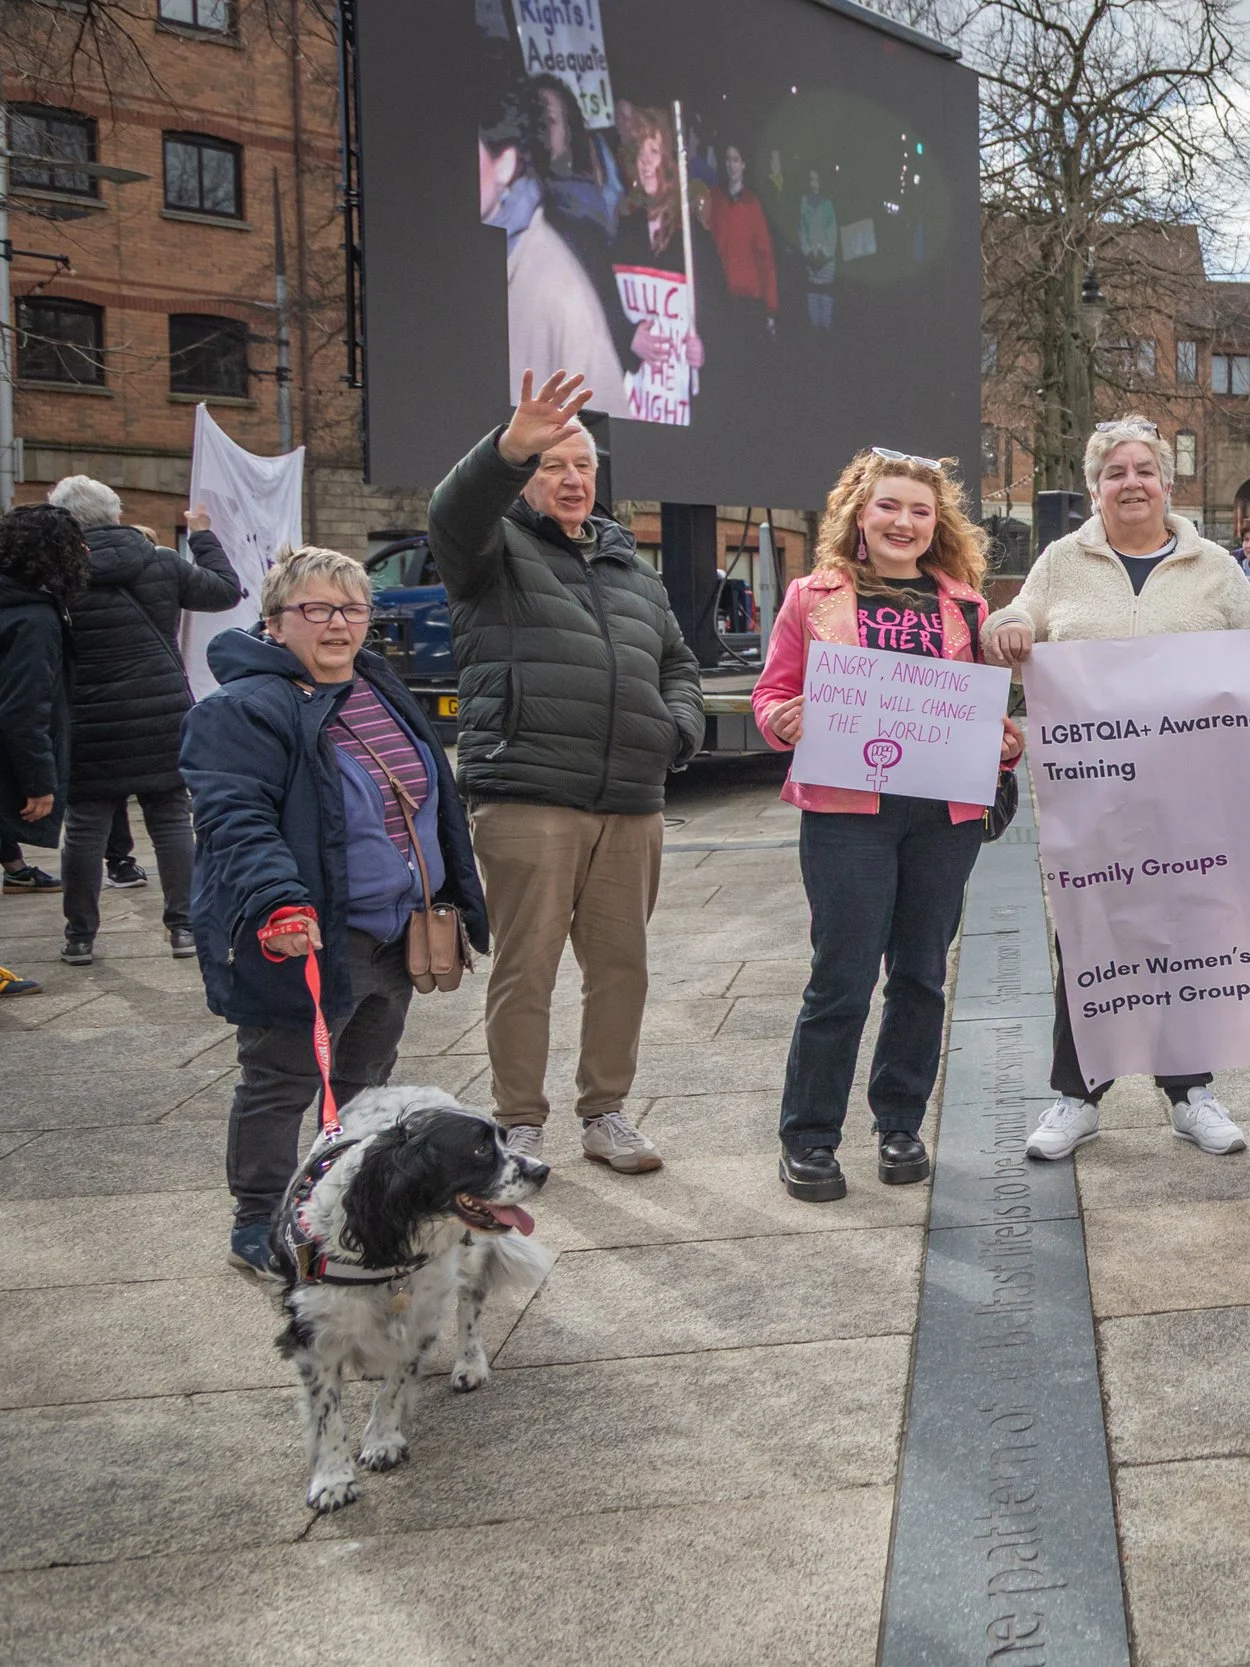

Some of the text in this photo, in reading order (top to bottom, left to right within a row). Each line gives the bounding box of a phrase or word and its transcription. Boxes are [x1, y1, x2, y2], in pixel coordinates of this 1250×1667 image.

[528, 36, 608, 83] Adequate
[815, 651, 972, 693] ANGRY, ANNOYING
[809, 682, 977, 722] WOMEN WILL CHANGE
[828, 713, 951, 745] THE WORLD!
[1041, 720, 1152, 745] LGBTQIA+
[1043, 759, 1136, 781] Training
[1059, 853, 1228, 889] Family Groups
[1077, 961, 1140, 989] Older
[1082, 981, 1250, 1018] Support Group
[982, 1073, 1025, 1094] the
[984, 1095, 1026, 1110] in
[979, 1111, 1027, 1155] found
[978, 1157, 1030, 1181] be
[984, 1183, 1031, 1202] to
[979, 1205, 1032, 1222] is
[977, 1225, 1034, 1259] life
[974, 1263, 1036, 1350] Belfast
